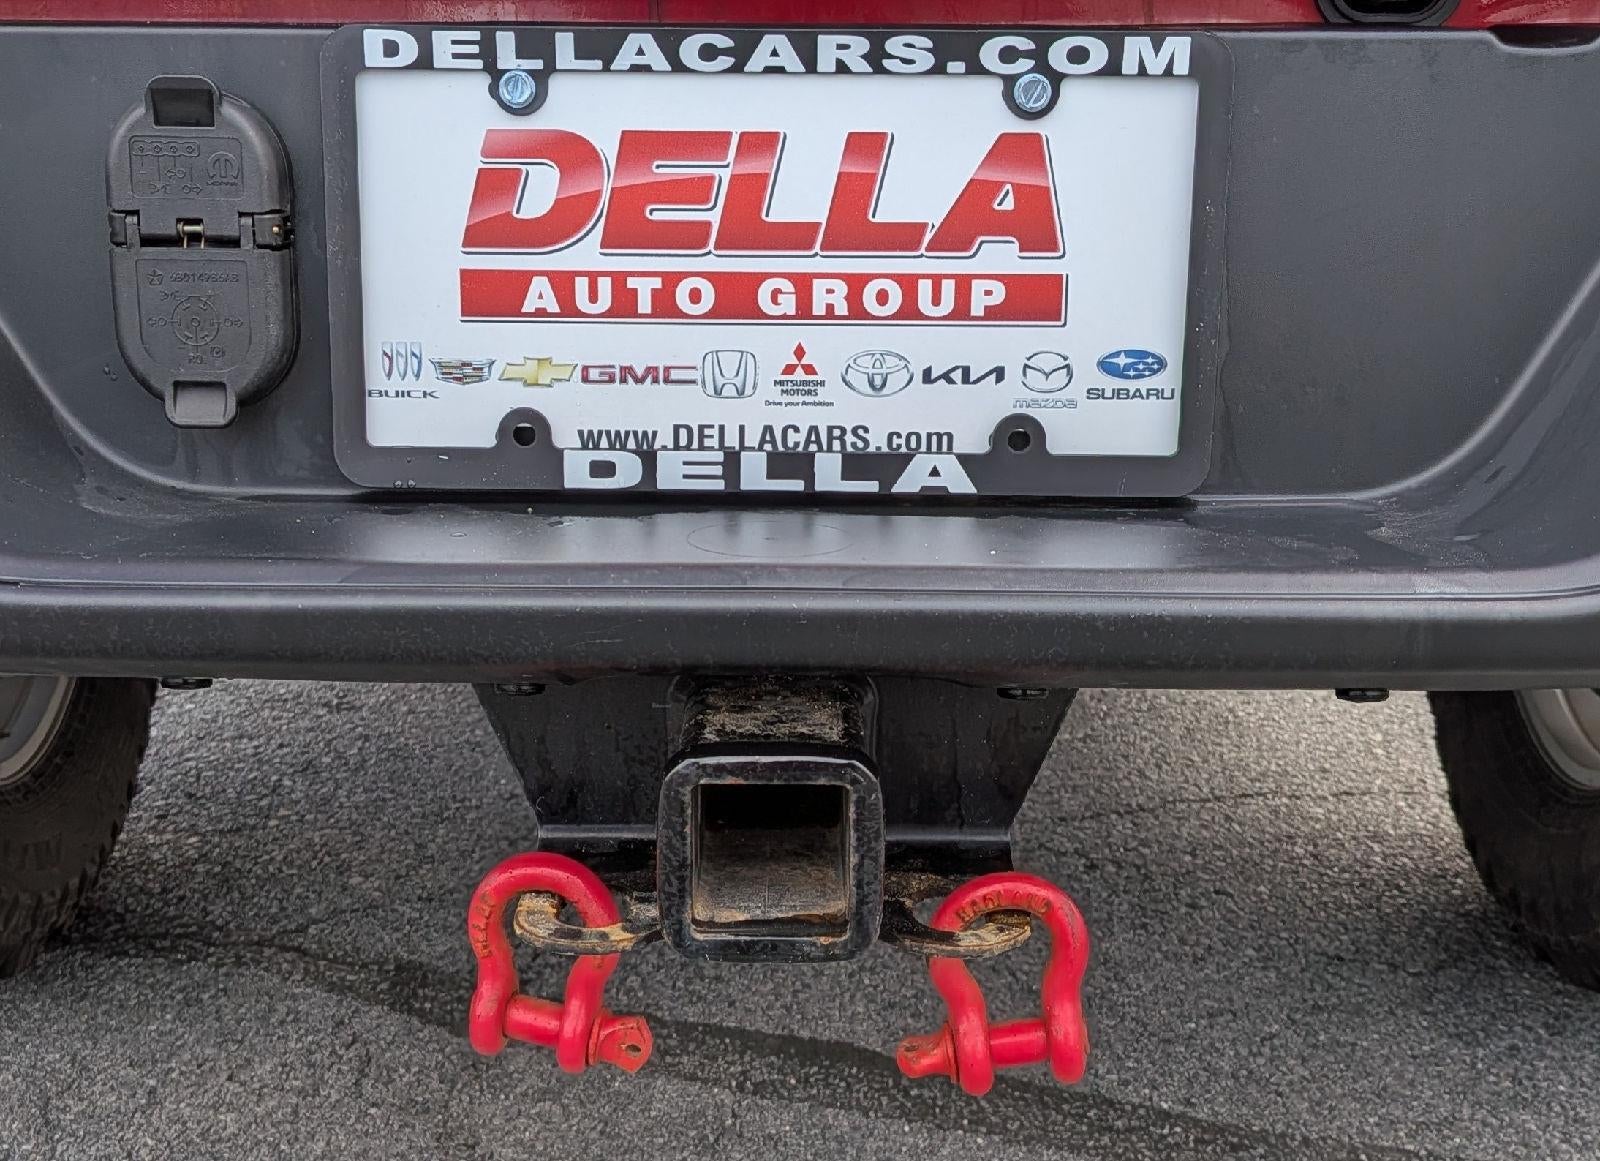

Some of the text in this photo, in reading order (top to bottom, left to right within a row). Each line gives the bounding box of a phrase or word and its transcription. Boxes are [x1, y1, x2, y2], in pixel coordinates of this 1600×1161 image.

[364, 29, 1193, 76] DELLACARS.COM
[460, 128, 1066, 258] DELLA
[520, 276, 1009, 318] AUTO GROUP
[580, 363, 699, 387] GMC
[773, 379, 826, 388] MITSUBISHI
[367, 389, 440, 399] BUICK
[780, 388, 819, 397] MOTORS
[1086, 386, 1176, 401] SUBARU
[577, 423, 955, 453] www.DELLACARS.com
[563, 449, 978, 493] DELLA
